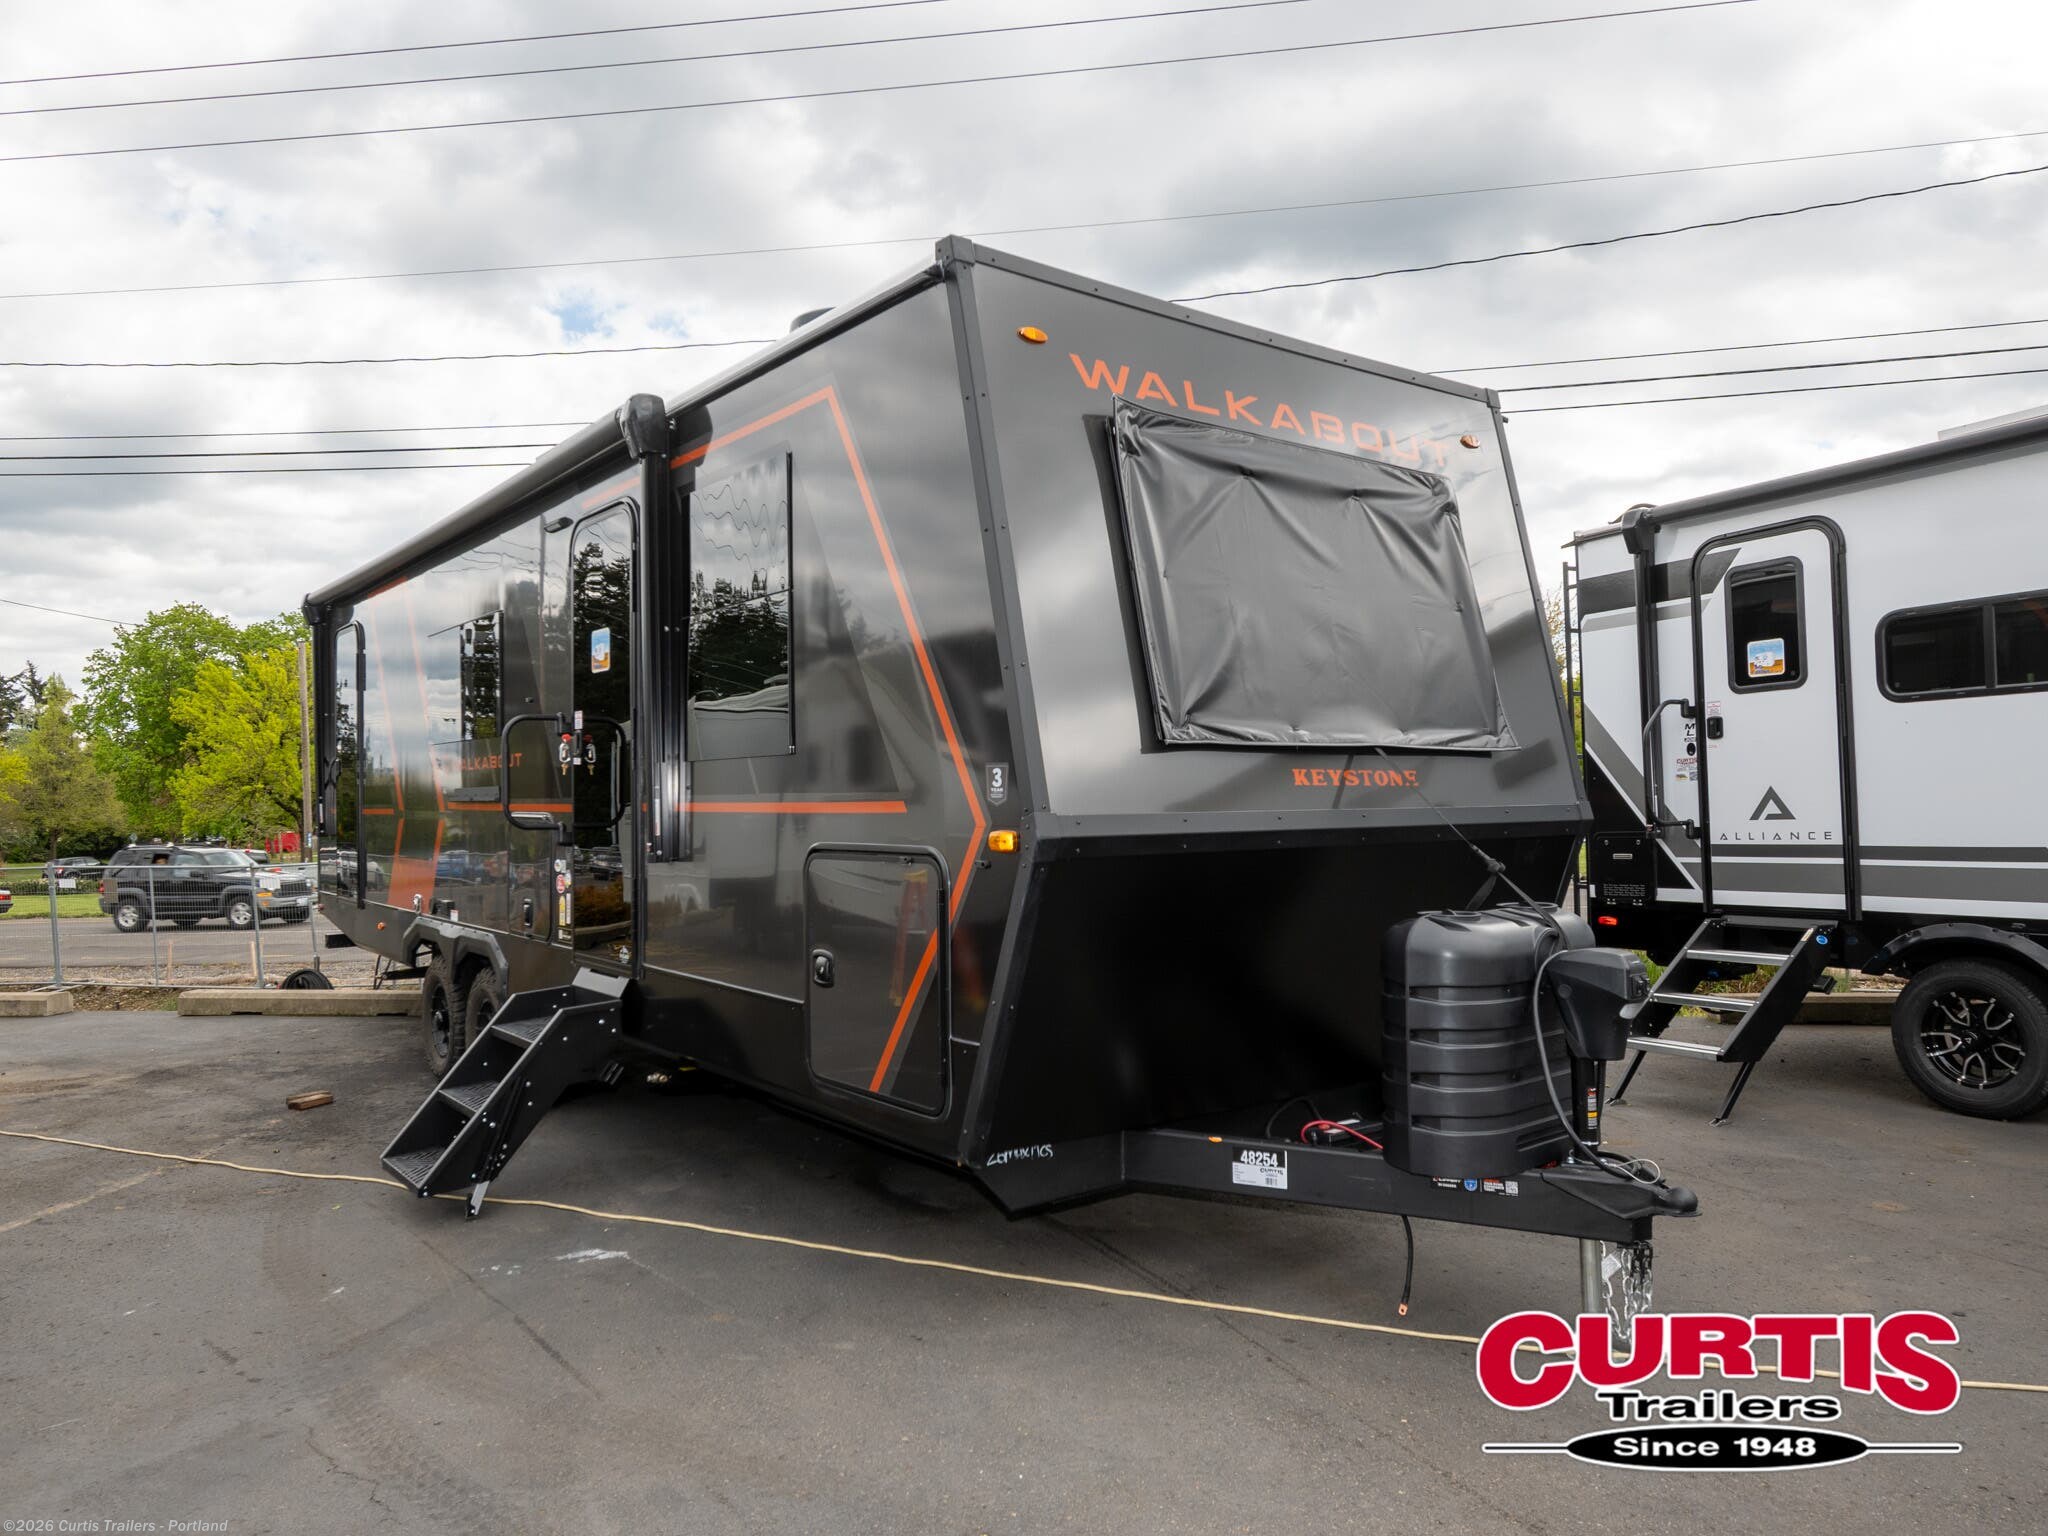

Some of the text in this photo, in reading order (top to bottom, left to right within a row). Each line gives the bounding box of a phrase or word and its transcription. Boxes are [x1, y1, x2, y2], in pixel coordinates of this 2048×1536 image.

[1068, 353, 1450, 466] WALKABOUT
[991, 767, 1003, 787] 3
[1291, 767, 1420, 787] KEYSTONE
[1720, 832, 1832, 840] ALLIANCE
[1240, 1149, 1278, 1167] 48254
